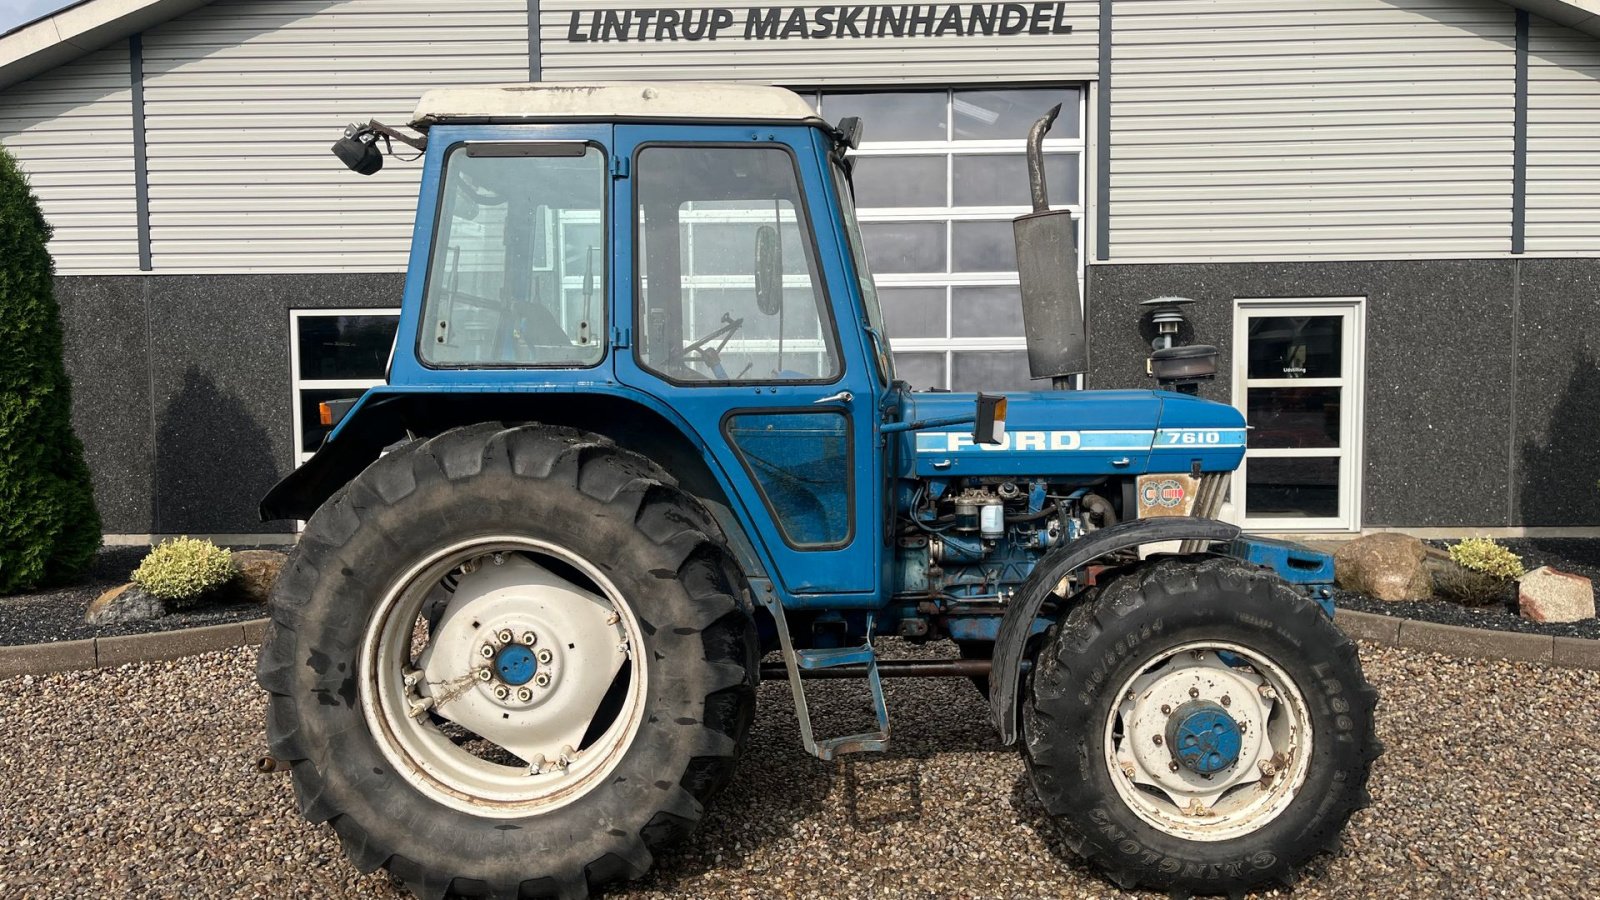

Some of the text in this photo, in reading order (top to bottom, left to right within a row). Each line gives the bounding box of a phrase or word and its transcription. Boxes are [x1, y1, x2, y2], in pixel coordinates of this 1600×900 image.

[567, 1, 1074, 42] LINTRUP MASKINHANDEL
[1167, 432, 1220, 444] 7610
